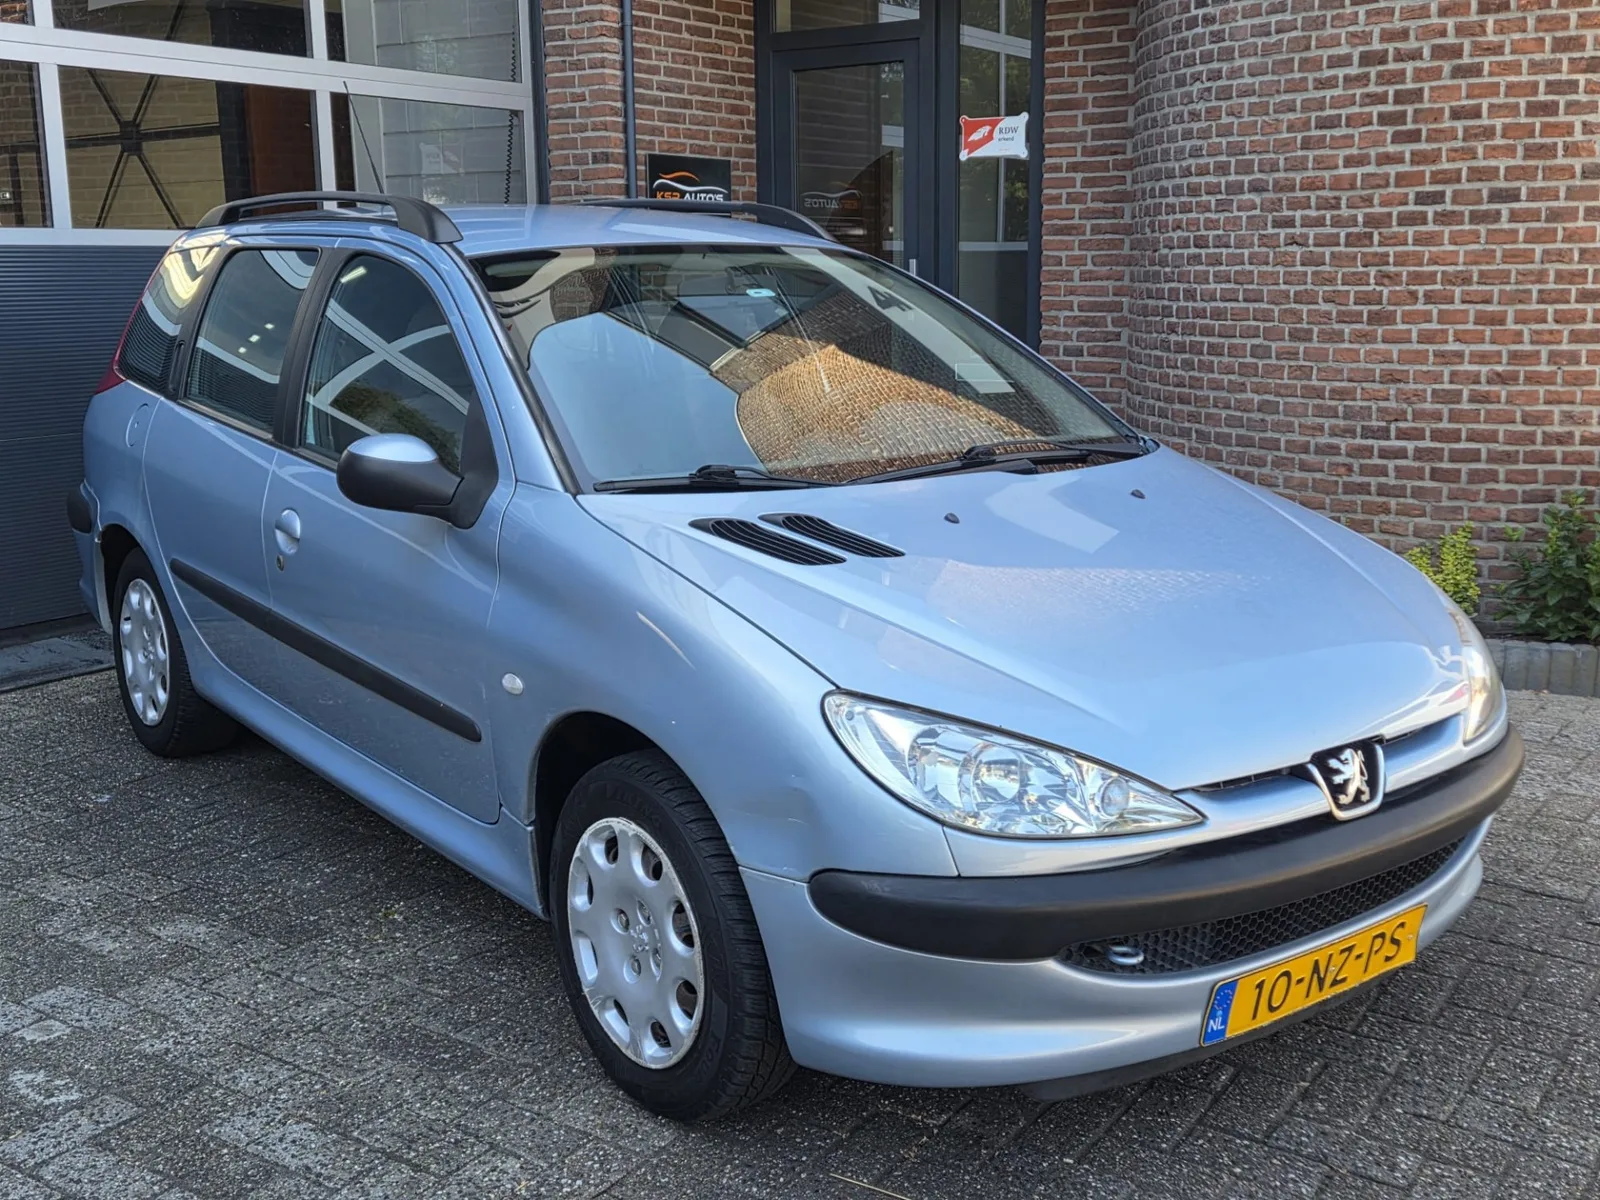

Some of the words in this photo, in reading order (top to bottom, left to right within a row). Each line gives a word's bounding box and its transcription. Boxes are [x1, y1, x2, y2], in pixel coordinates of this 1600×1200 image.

[998, 125, 1020, 135] RDW
[1251, 921, 1407, 1021] 10-NZ-PS
[1207, 1016, 1225, 1033] NL
